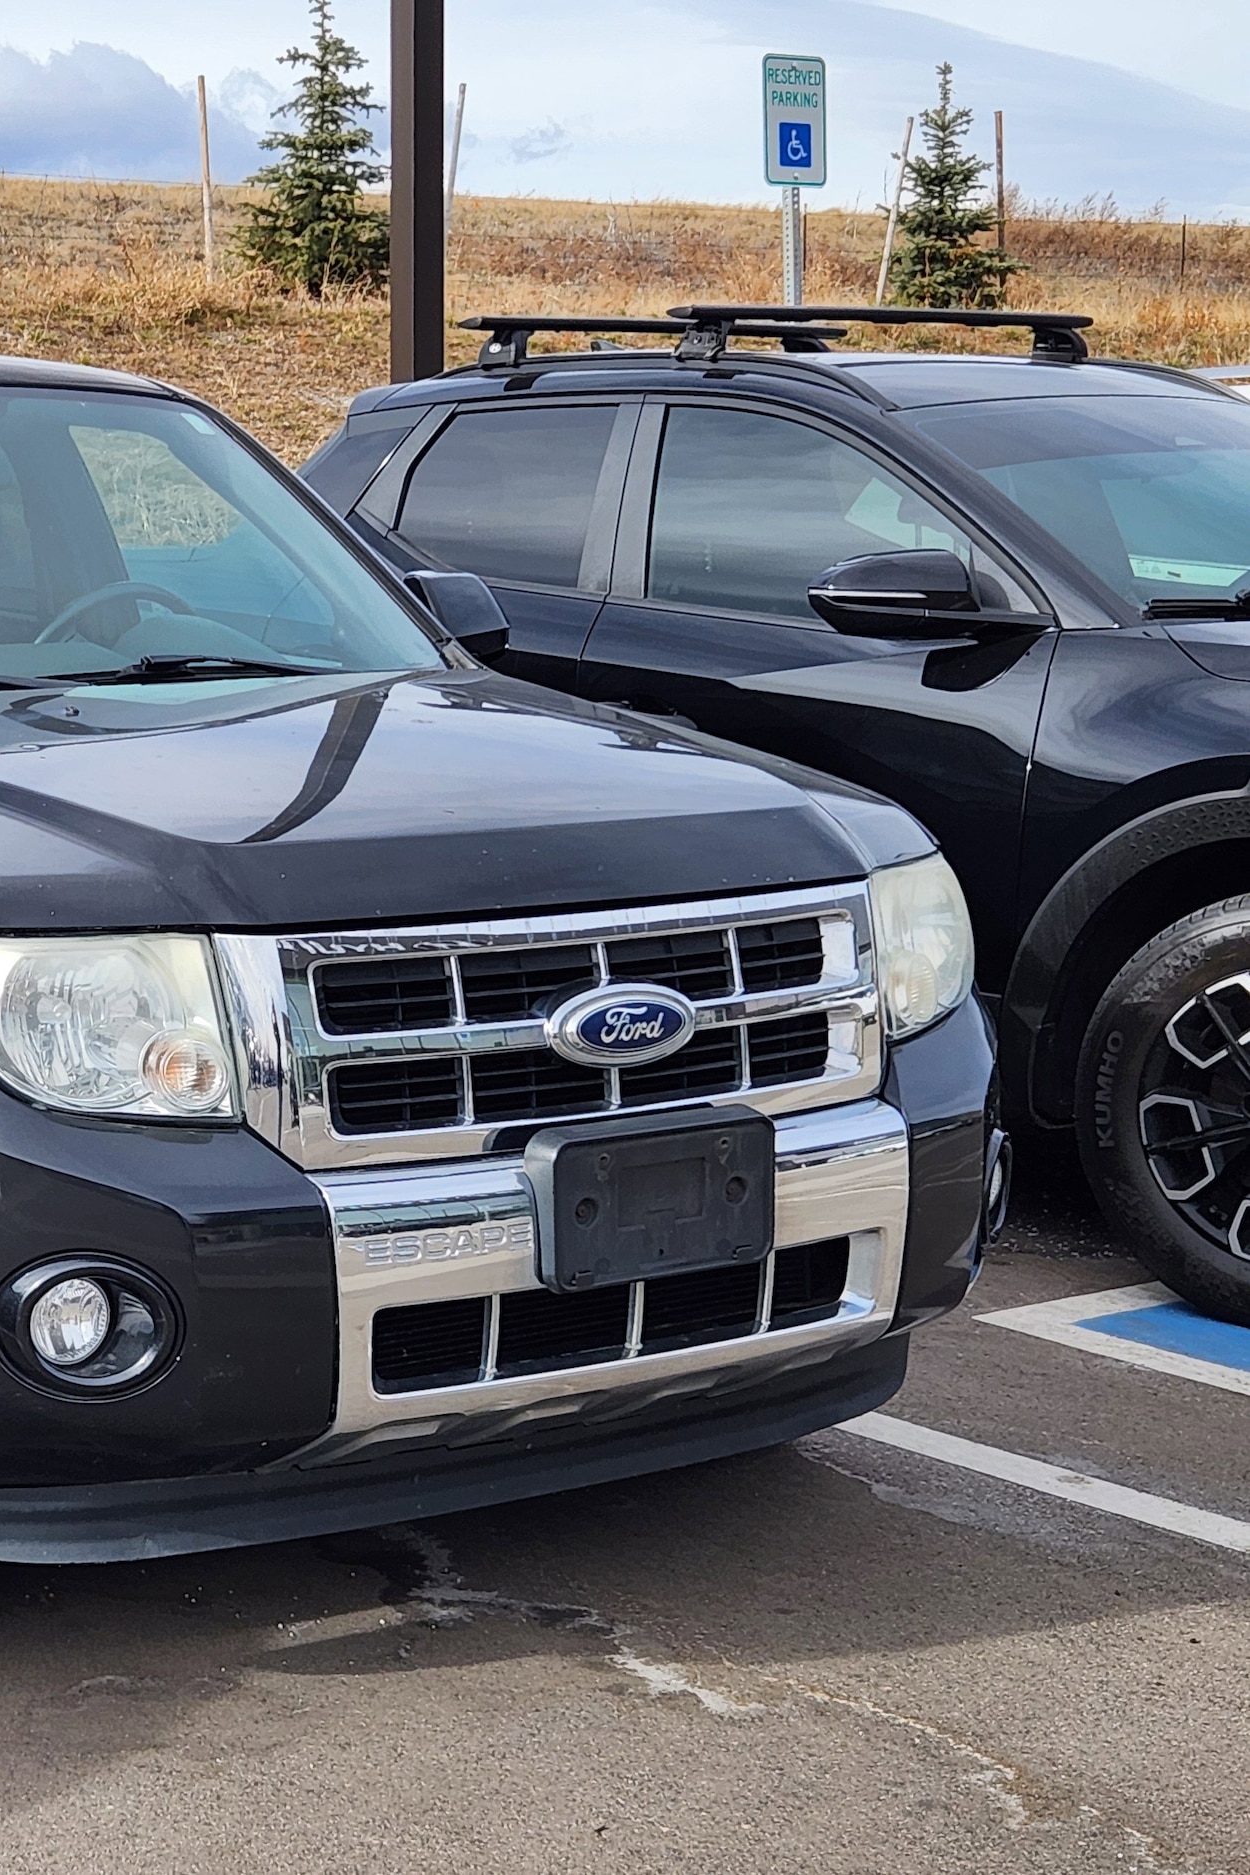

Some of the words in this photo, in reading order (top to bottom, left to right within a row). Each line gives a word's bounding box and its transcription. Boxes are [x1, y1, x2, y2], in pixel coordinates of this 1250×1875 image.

[767, 67, 821, 86] RESERVED
[771, 90, 818, 109] PARKING
[600, 1005, 665, 1044] Ford
[1094, 1030, 1125, 1148] KUMHO
[364, 1222, 533, 1267] ESCAPE
